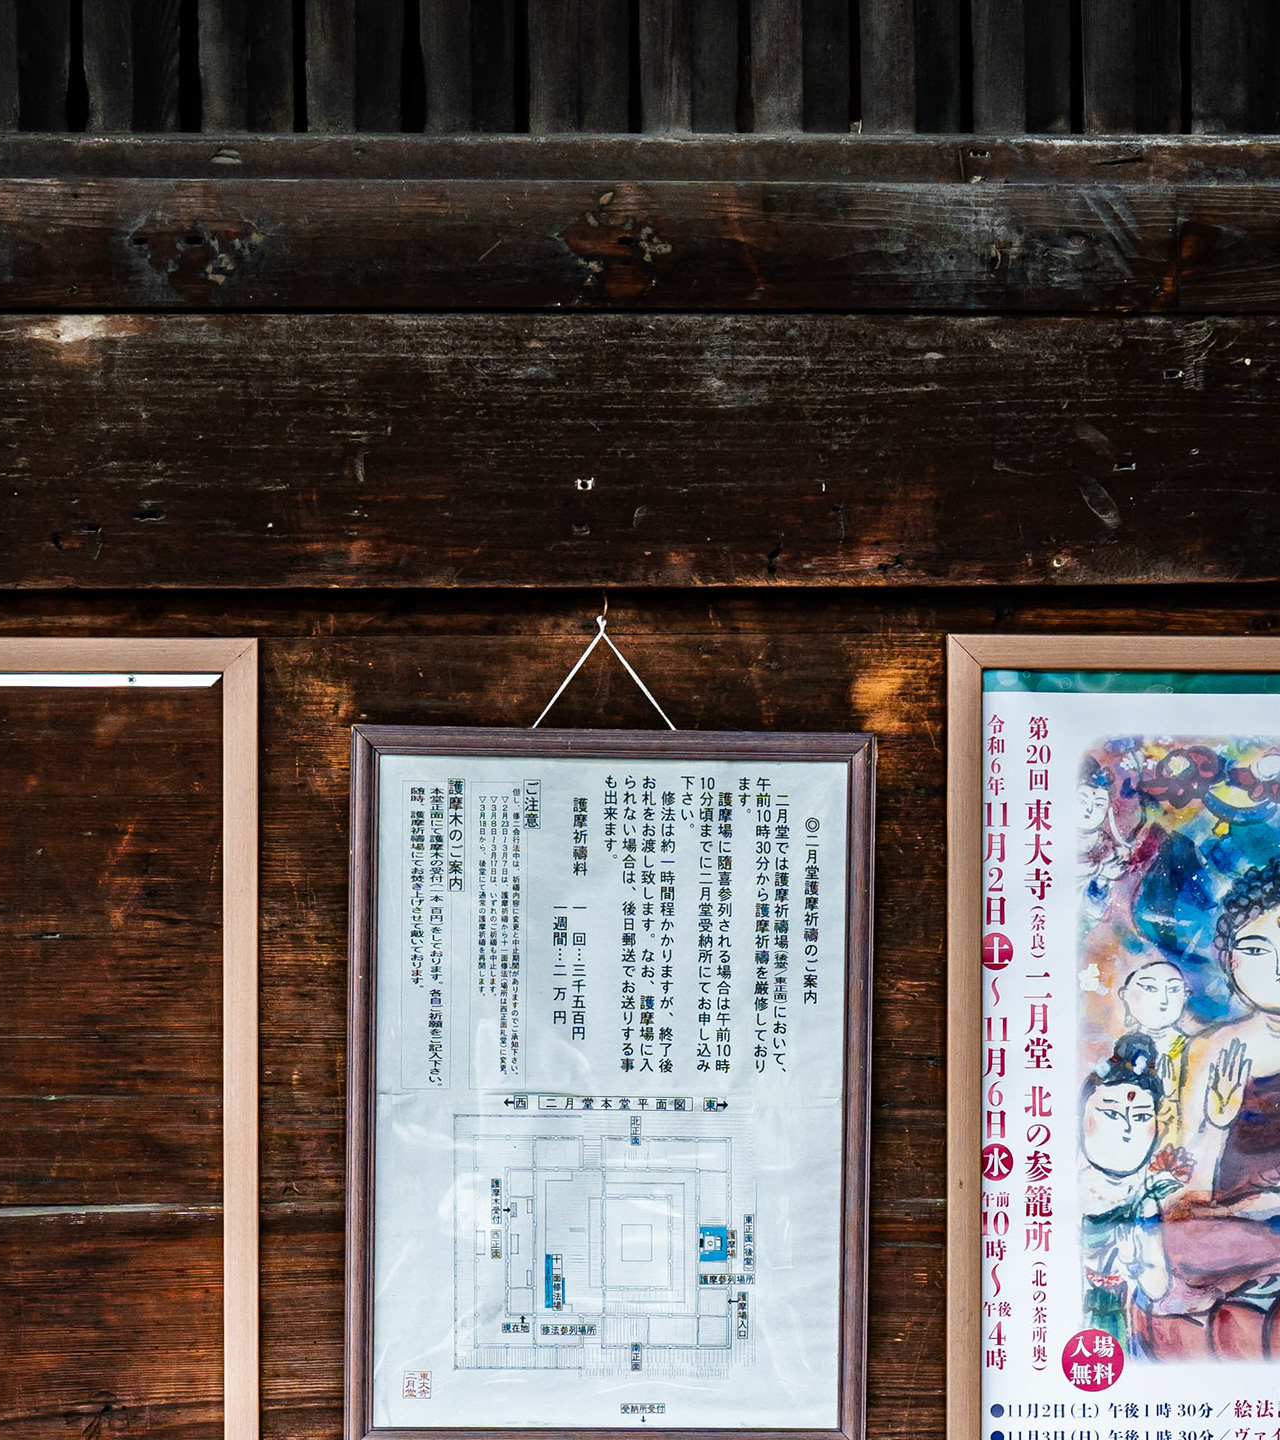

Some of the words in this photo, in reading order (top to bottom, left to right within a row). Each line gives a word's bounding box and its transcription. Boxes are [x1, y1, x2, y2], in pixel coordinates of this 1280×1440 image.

[1026, 715, 1052, 791] 第20回
[524, 781, 540, 828] ご注意
[603, 774, 618, 860] も出来ます。
[680, 775, 695, 829] 下さい。
[738, 776, 751, 814] ます。
[448, 779, 463, 891] 護摩木のご案内
[545, 1097, 686, 1110] 二月堂本堂平面図
[1070, 1335, 1115, 1358] 入場
[1069, 1362, 1115, 1386] 無料
